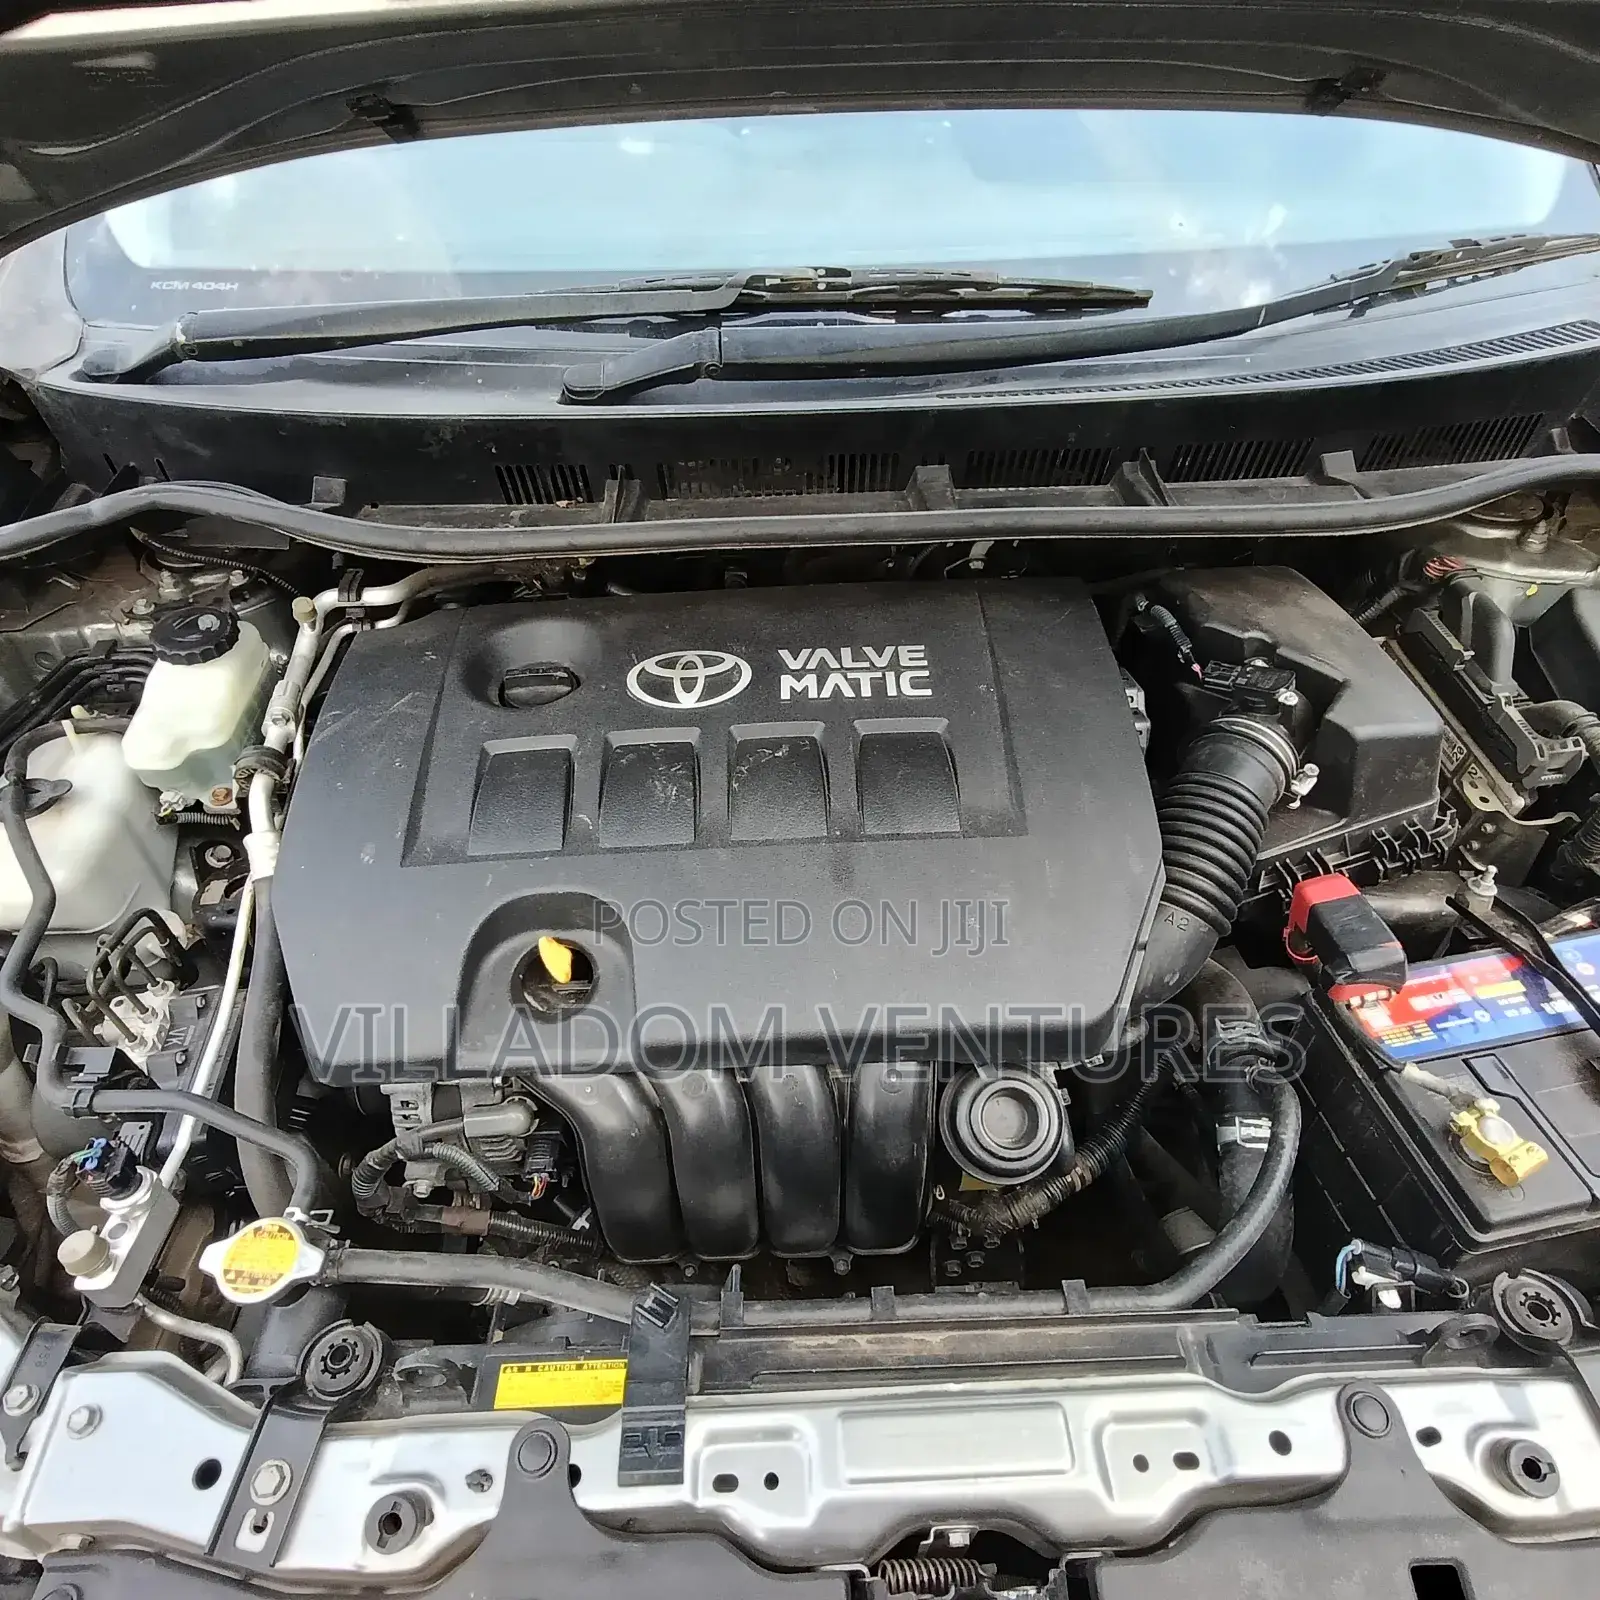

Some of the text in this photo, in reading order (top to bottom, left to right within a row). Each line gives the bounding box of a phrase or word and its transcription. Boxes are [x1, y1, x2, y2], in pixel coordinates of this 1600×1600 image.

[778, 644, 928, 670] VALVE
[780, 670, 933, 700] MATIC
[1163, 911, 1190, 932] A2
[538, 1363, 576, 1373] CAUTION
[582, 1361, 626, 1371] ATTENTION
